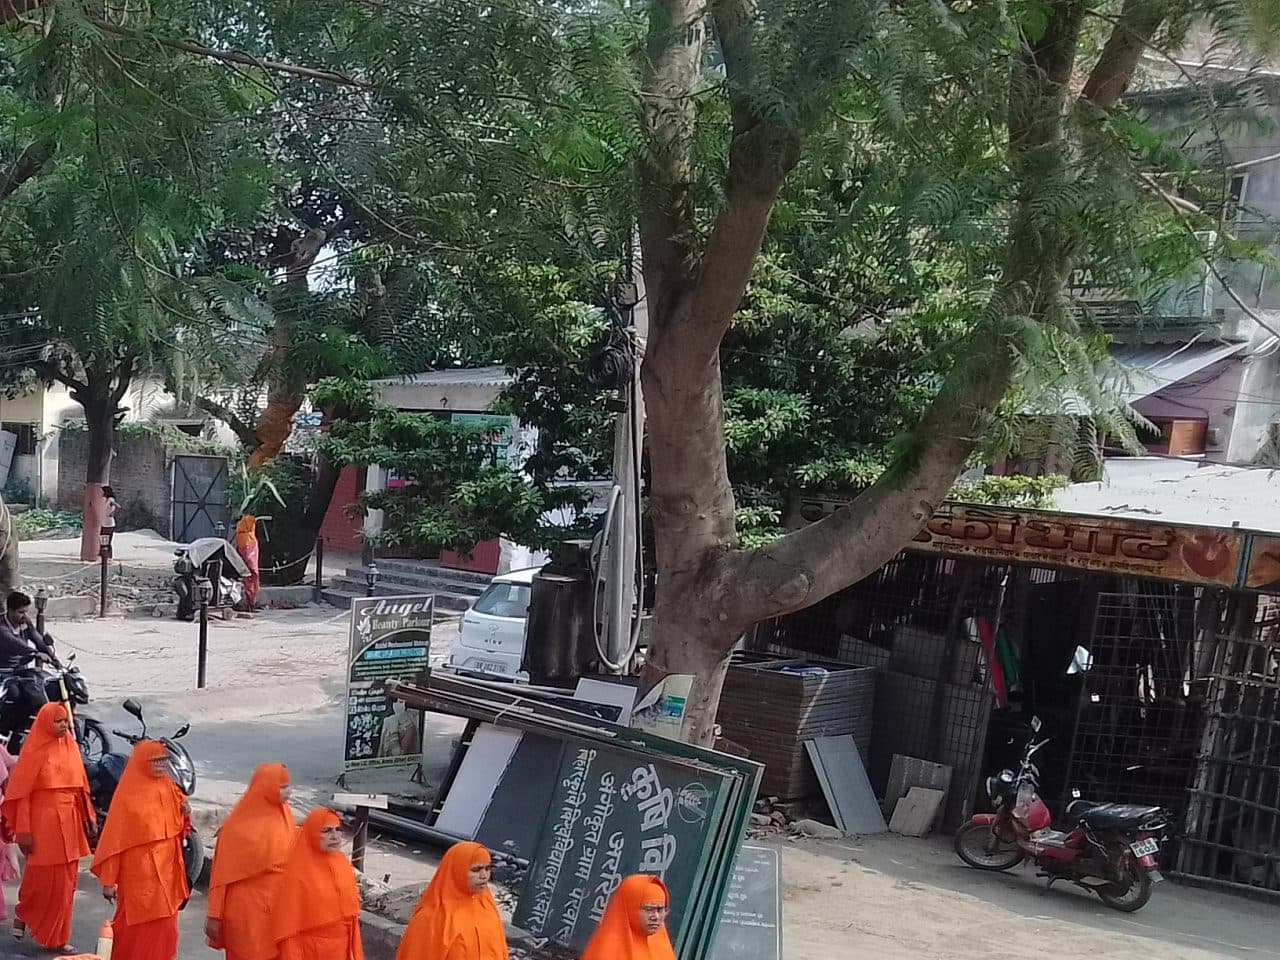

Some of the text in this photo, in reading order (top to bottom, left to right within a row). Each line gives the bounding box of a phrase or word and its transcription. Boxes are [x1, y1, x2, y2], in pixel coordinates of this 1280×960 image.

[361, 597, 433, 616] Angel
[372, 617, 431, 630] Beauty Parlour
[622, 764, 673, 831] कृषि
[589, 832, 625, 922] अररिया
